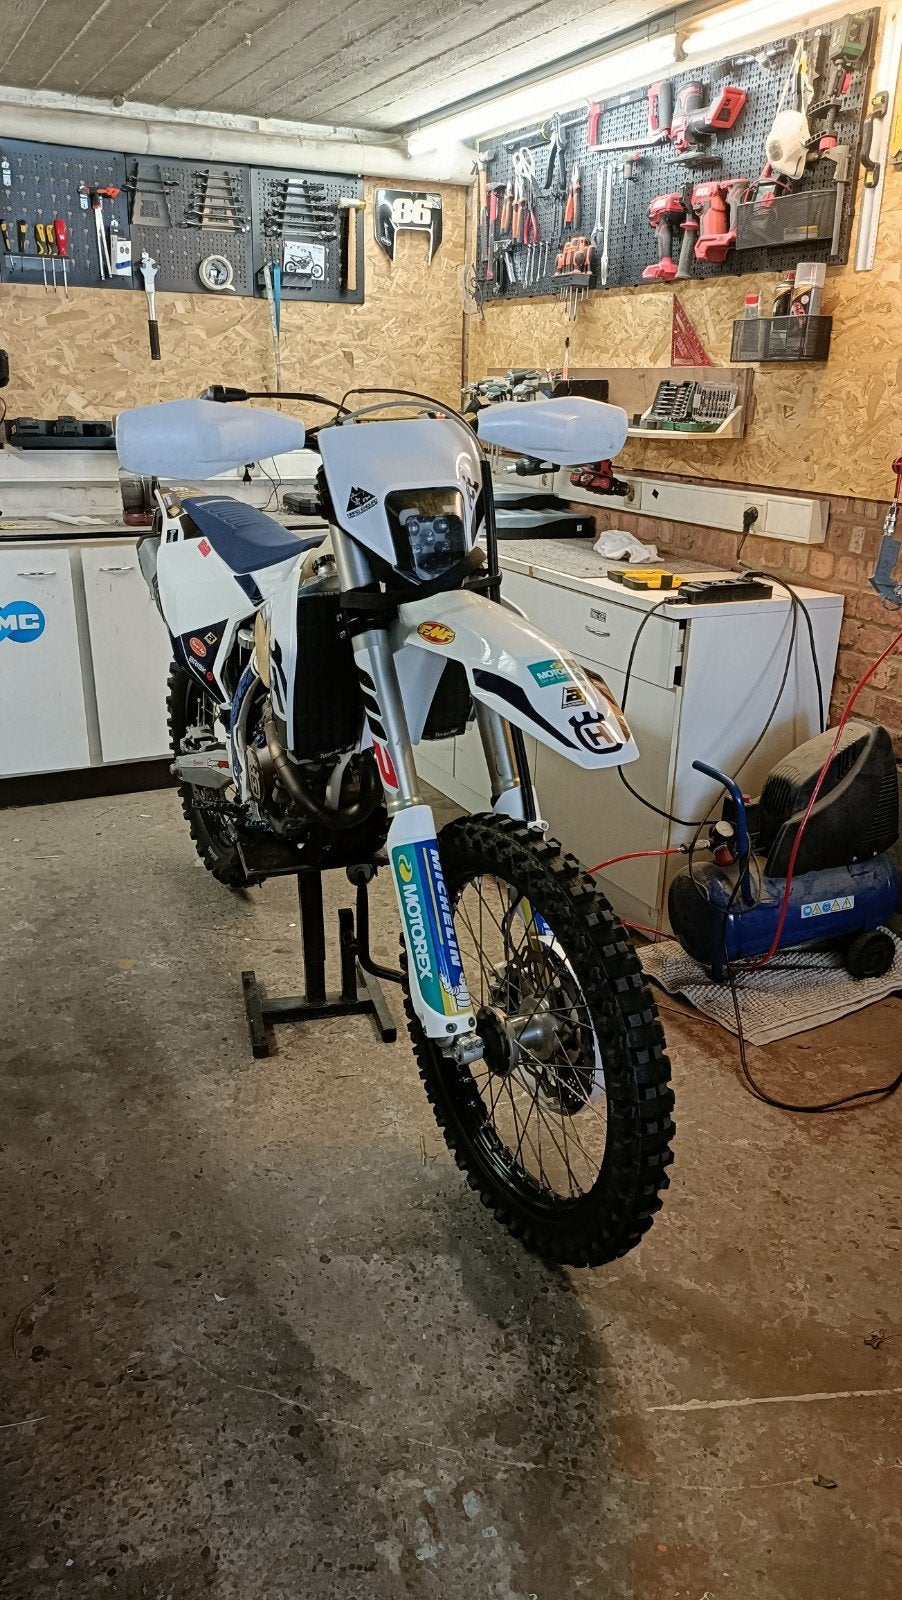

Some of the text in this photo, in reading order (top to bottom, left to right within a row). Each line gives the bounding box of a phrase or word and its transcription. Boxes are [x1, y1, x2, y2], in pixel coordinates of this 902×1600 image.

[391, 198, 432, 225] 86
[402, 883, 433, 981] MOTOREX
[430, 848, 461, 967] MICHELIN
